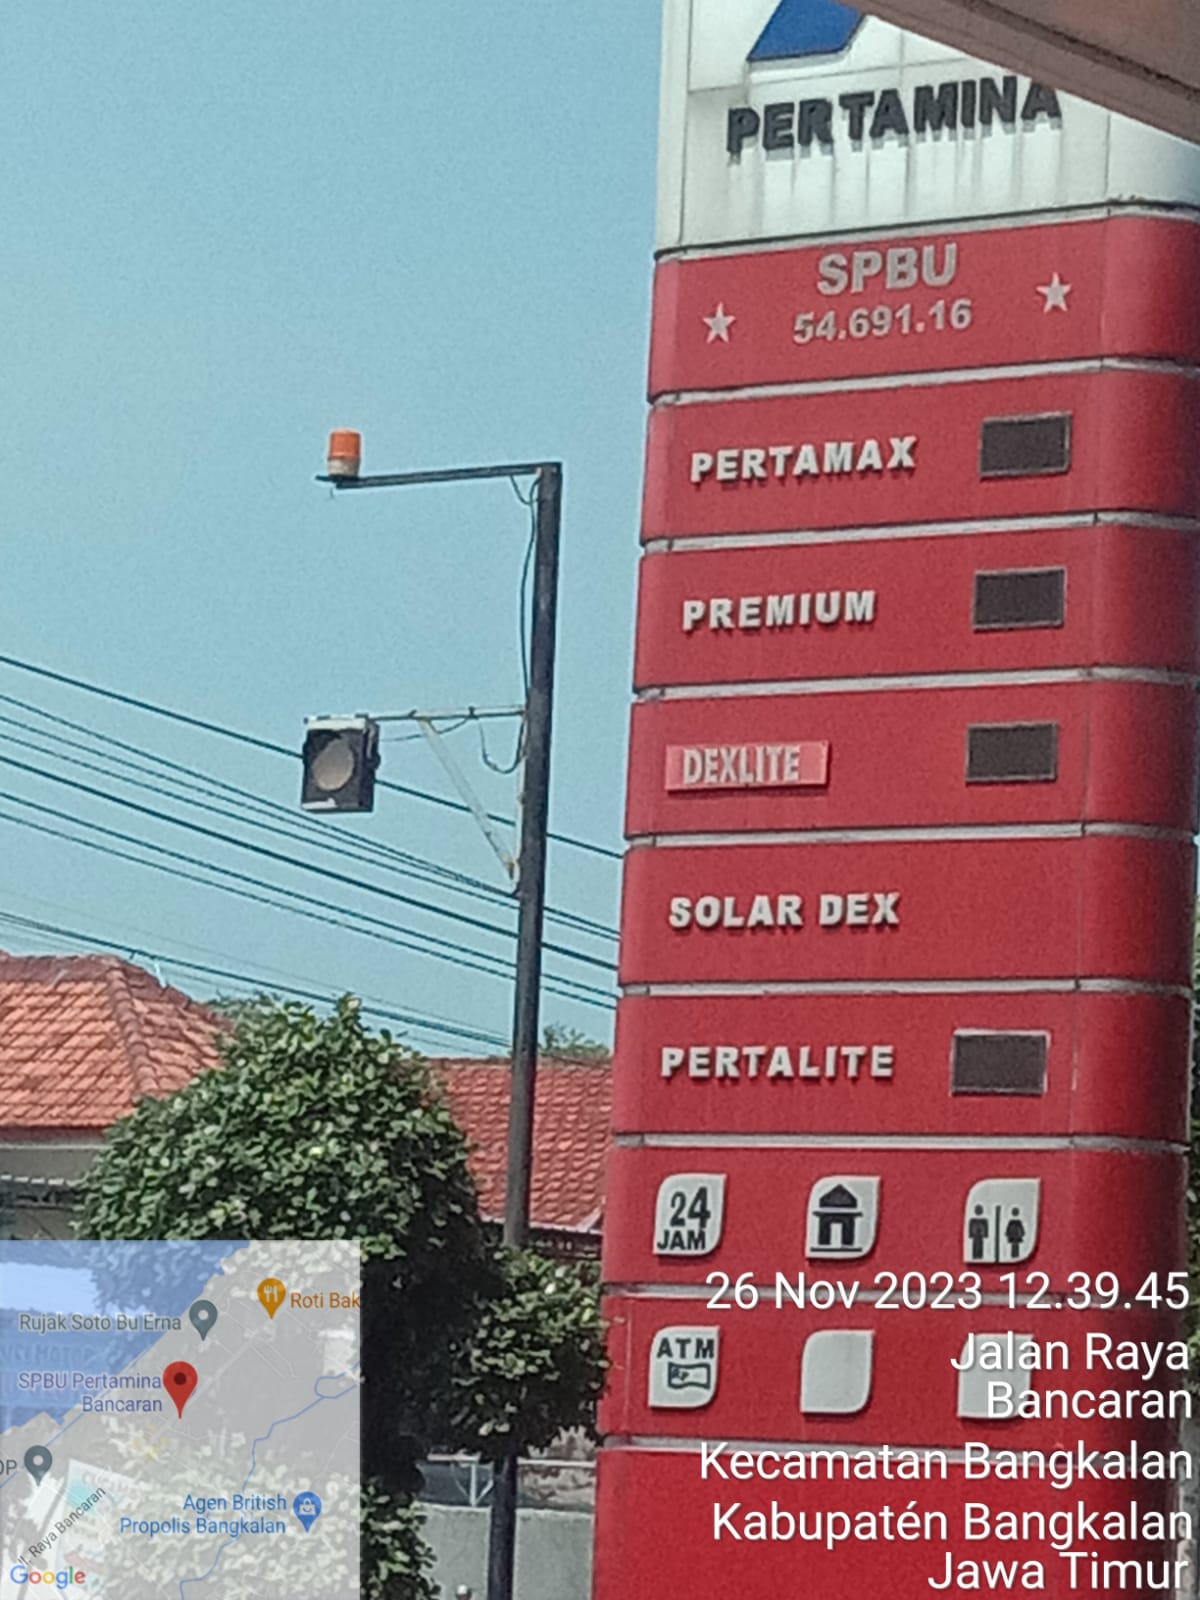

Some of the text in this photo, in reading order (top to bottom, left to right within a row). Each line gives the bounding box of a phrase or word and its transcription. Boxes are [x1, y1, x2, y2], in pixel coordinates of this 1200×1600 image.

[726, 75, 1062, 152] PERTAMINA
[817, 243, 958, 296] SPBU
[793, 299, 973, 345] 54.691.16
[690, 436, 918, 484] PERTAMAX
[682, 590, 876, 632] PREMIUM
[683, 745, 801, 785] DEXLITE
[668, 892, 900, 928] SOLAR DEX
[660, 1045, 895, 1079] PERTALITE
[669, 1186, 711, 1228] 24
[657, 1229, 706, 1250] JAM
[656, 1338, 715, 1359] ATM
